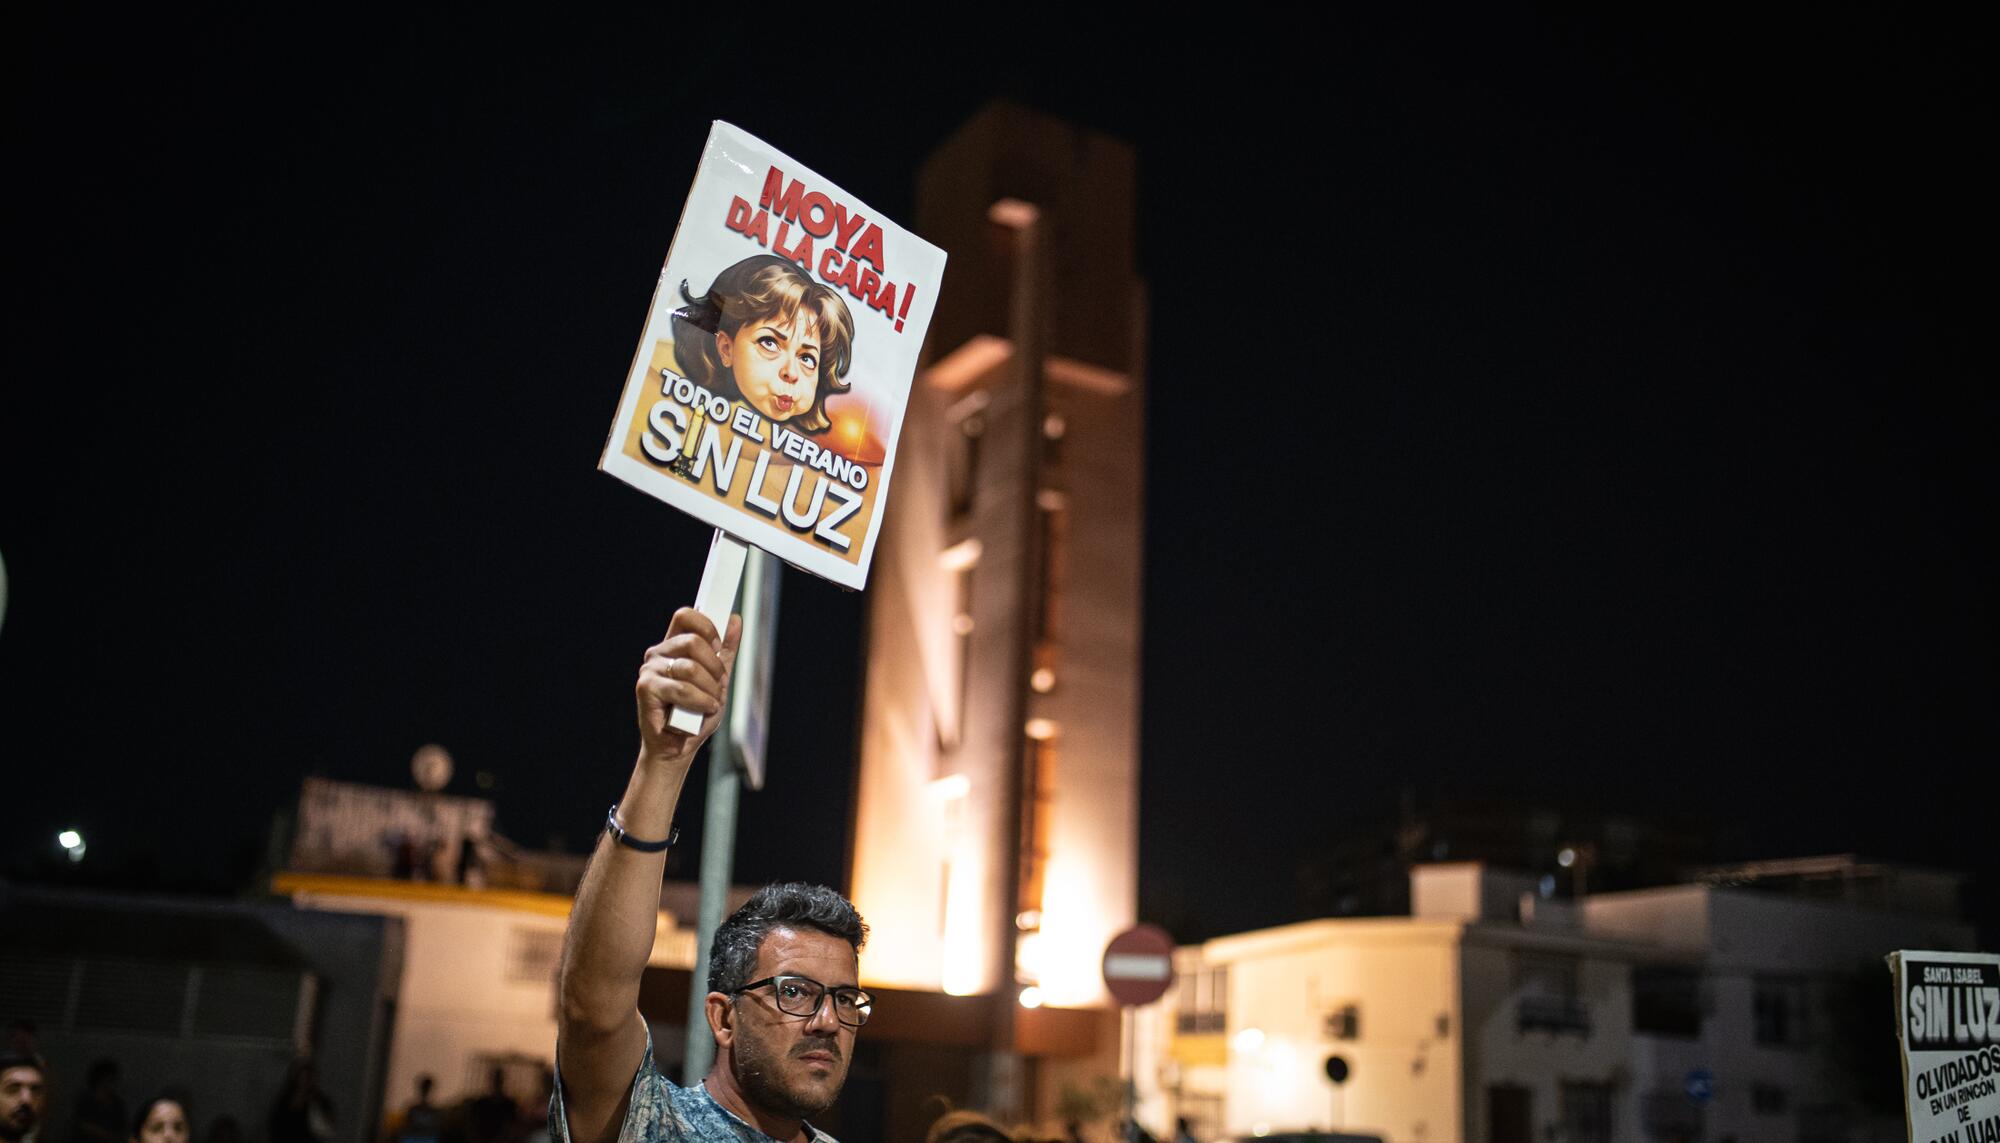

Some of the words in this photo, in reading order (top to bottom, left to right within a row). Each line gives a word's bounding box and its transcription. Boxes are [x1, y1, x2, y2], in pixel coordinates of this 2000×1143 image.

[760, 165, 884, 274] MOYA
[725, 195, 769, 247] DA
[772, 220, 813, 272] LA
[818, 248, 916, 334] CARA!
[661, 368, 730, 423] TODO
[732, 406, 764, 443] EL
[771, 423, 868, 490] VERANO
[745, 449, 863, 550] LUZ
[1924, 966, 1951, 983] SANTA
[1953, 968, 1984, 984] ISABEL
[1910, 985, 1949, 1042] SIN
[1953, 986, 2000, 1042] LUZ
[1917, 1047, 2000, 1100] OLVIDADOS
[1930, 1098, 1943, 1116] EN
[1944, 1091, 1957, 1109] UN
[1957, 1105, 1971, 1123] DE
